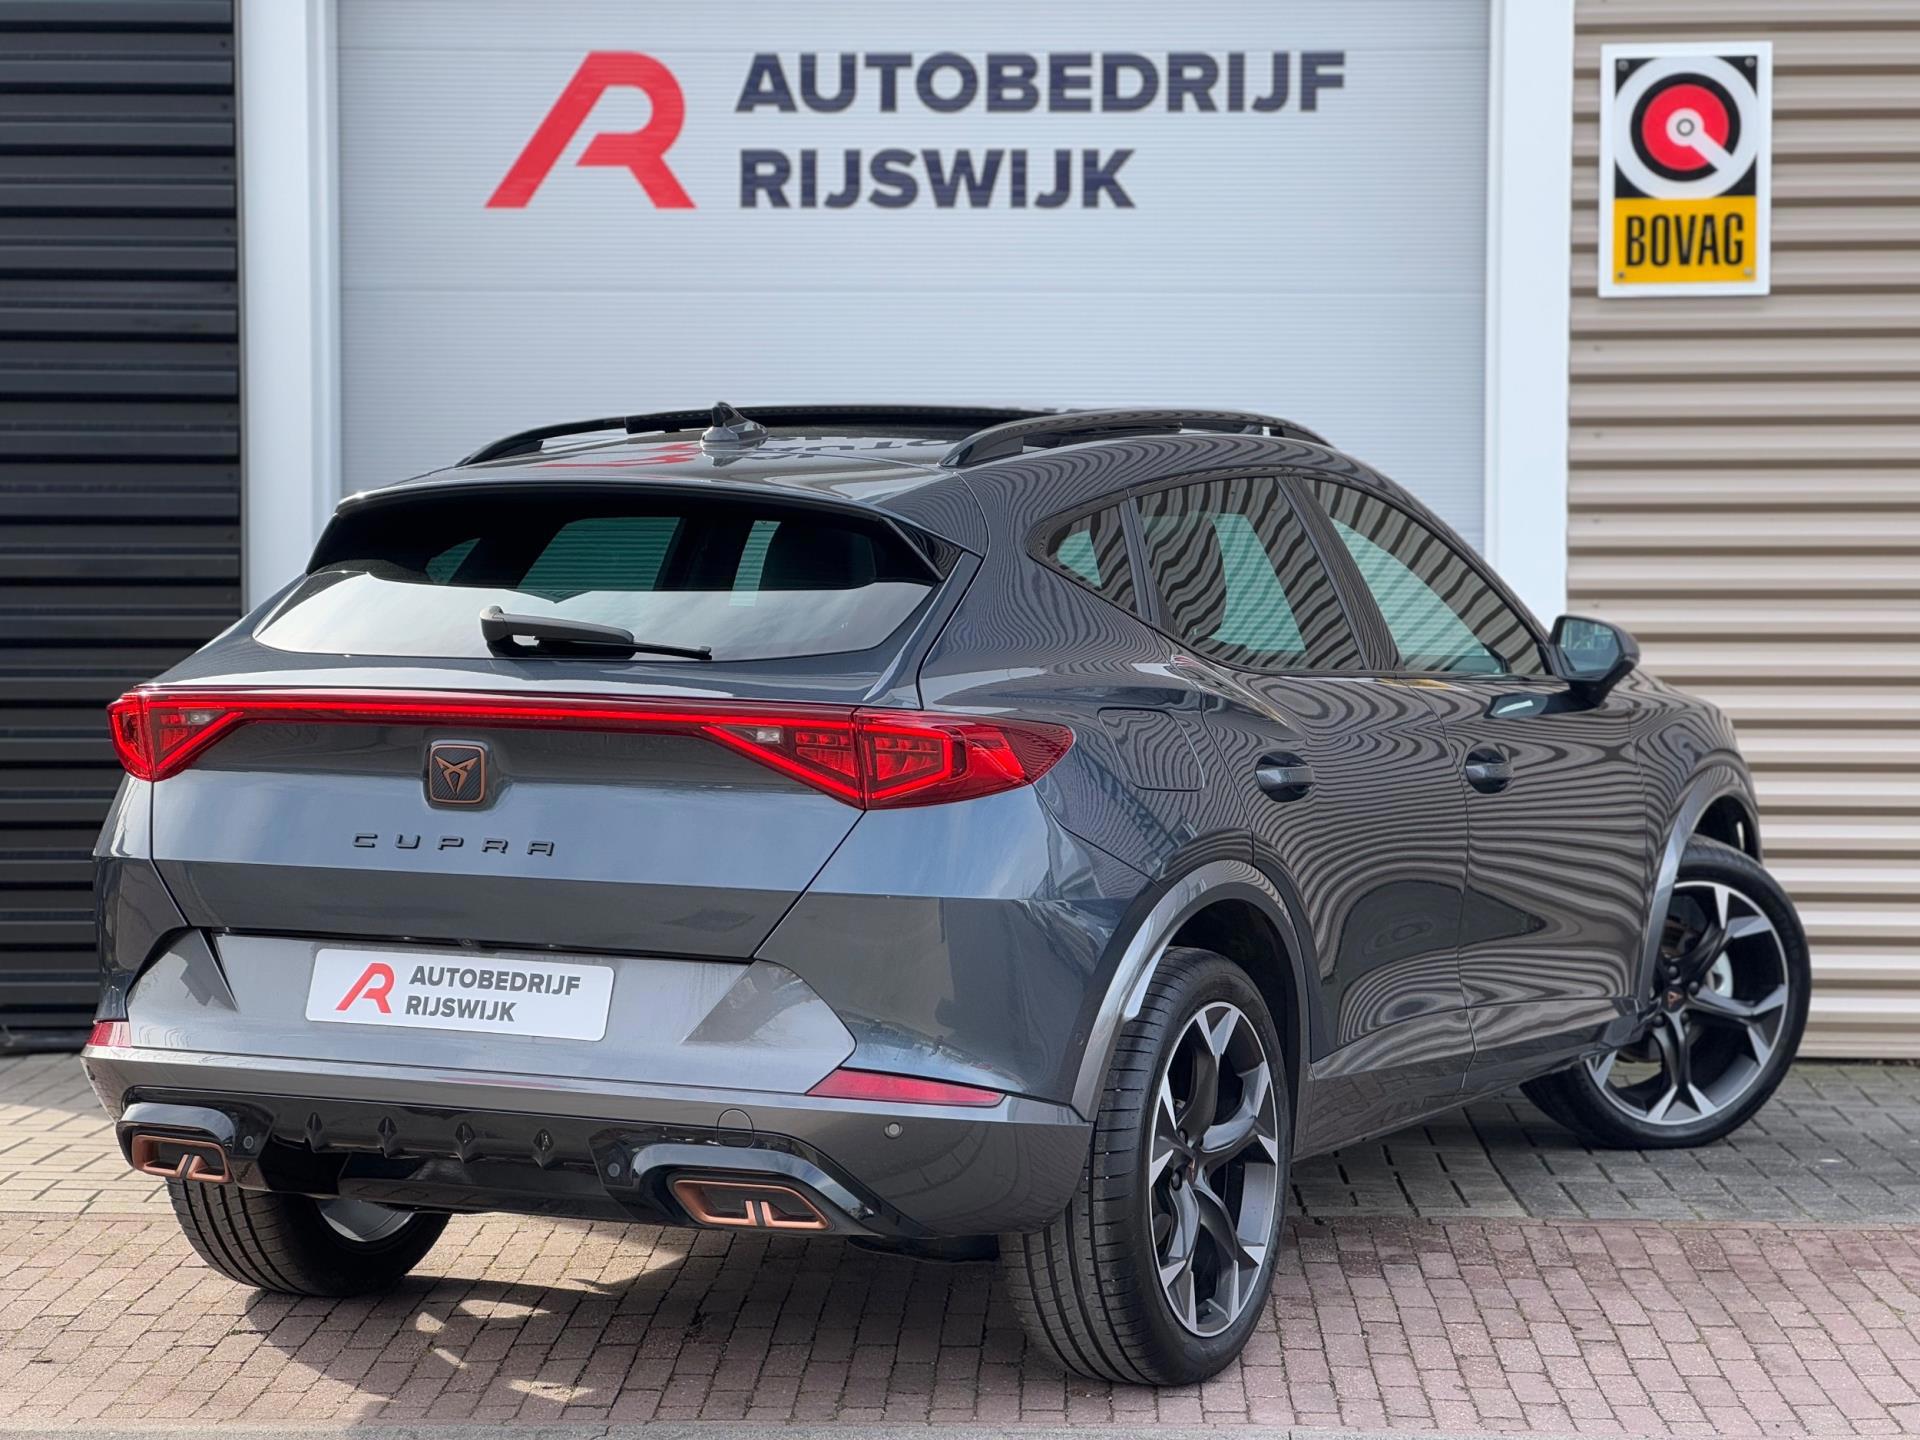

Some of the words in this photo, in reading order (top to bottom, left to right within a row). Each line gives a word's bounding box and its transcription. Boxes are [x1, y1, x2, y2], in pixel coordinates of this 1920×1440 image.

[735, 51, 1345, 114] AUTOBEDRIJF
[739, 149, 1136, 209] RIJSWIJK
[1626, 212, 1744, 266] BOVAG
[352, 833, 555, 856] CUPRA
[410, 965, 581, 995] AUTOBEDRIJF
[405, 996, 516, 1021] RIJSWIJK
